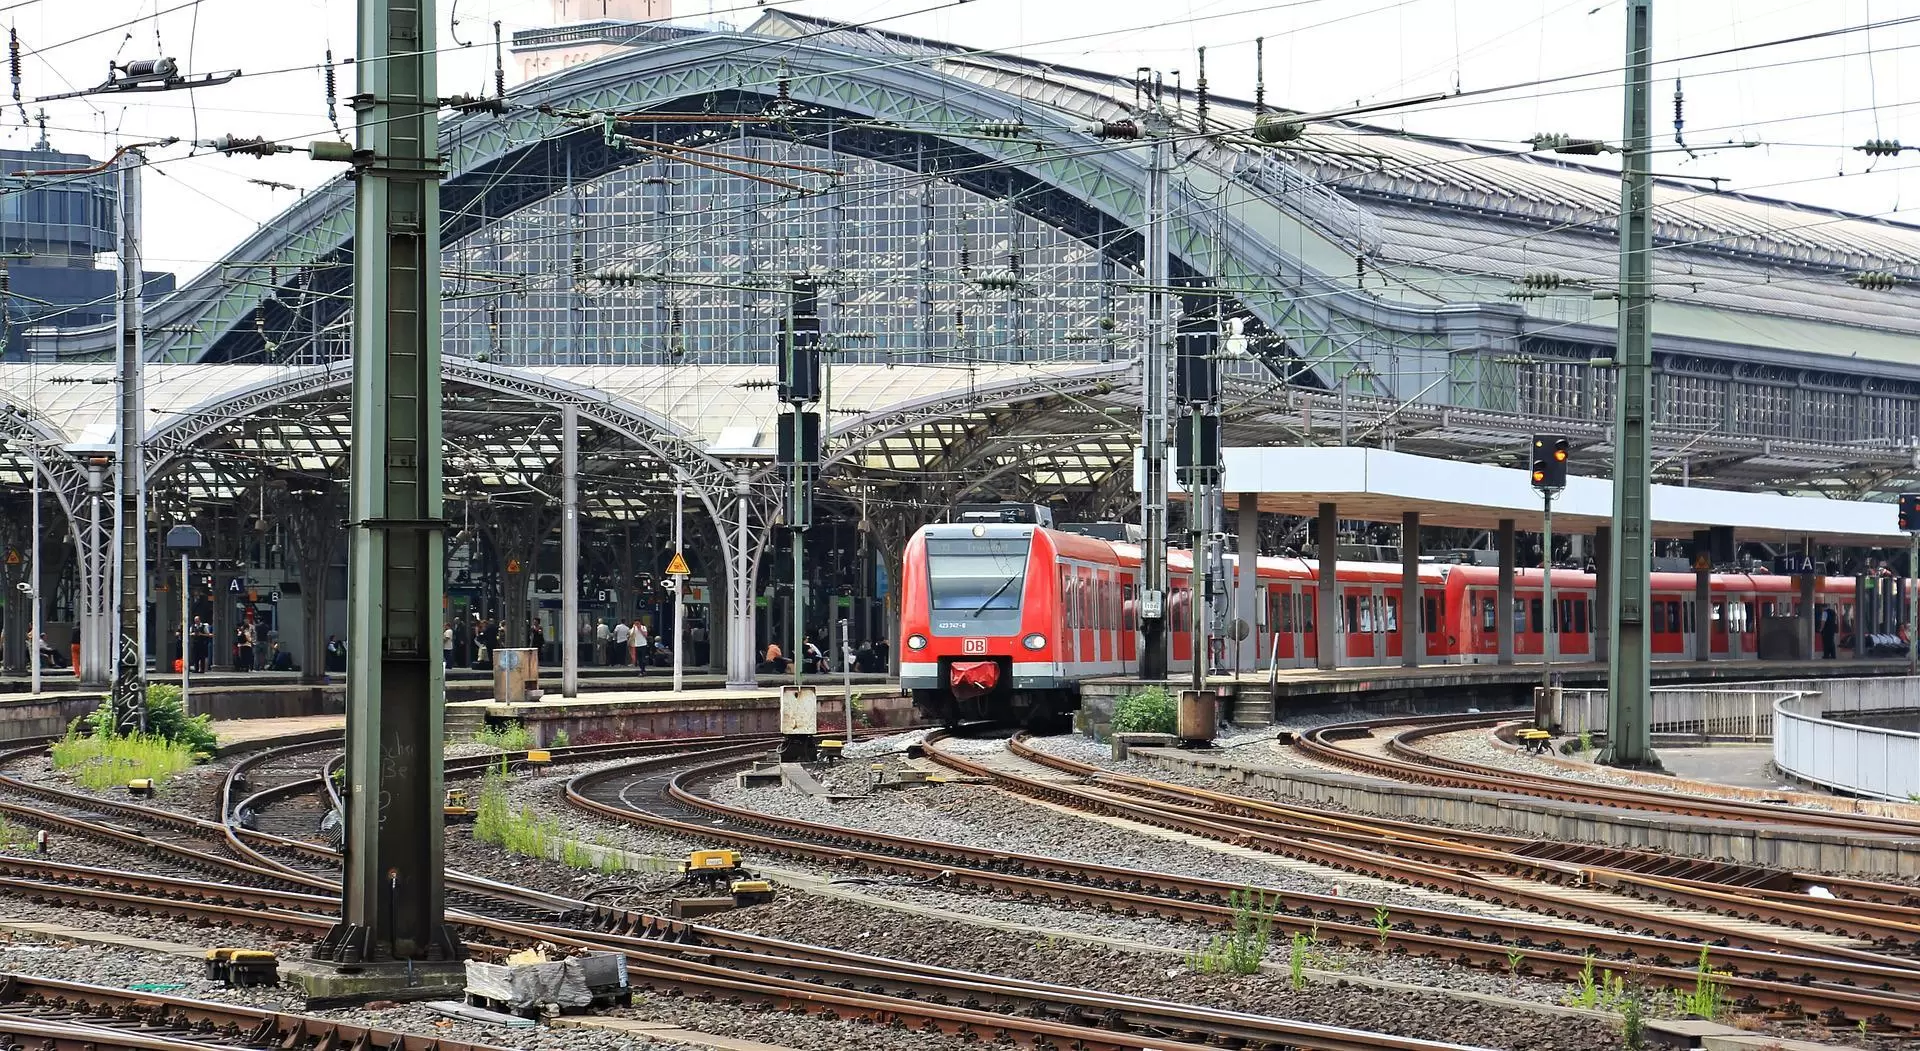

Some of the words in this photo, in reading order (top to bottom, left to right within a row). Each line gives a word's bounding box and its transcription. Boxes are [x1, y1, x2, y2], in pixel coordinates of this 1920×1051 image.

[1586, 556, 1596, 571] A
[1783, 556, 1795, 570] 11
[1802, 556, 1813, 570] A
[229, 579, 240, 591] A
[271, 592, 279, 602] B
[598, 590, 606, 601] B
[966, 640, 984, 652] DB
